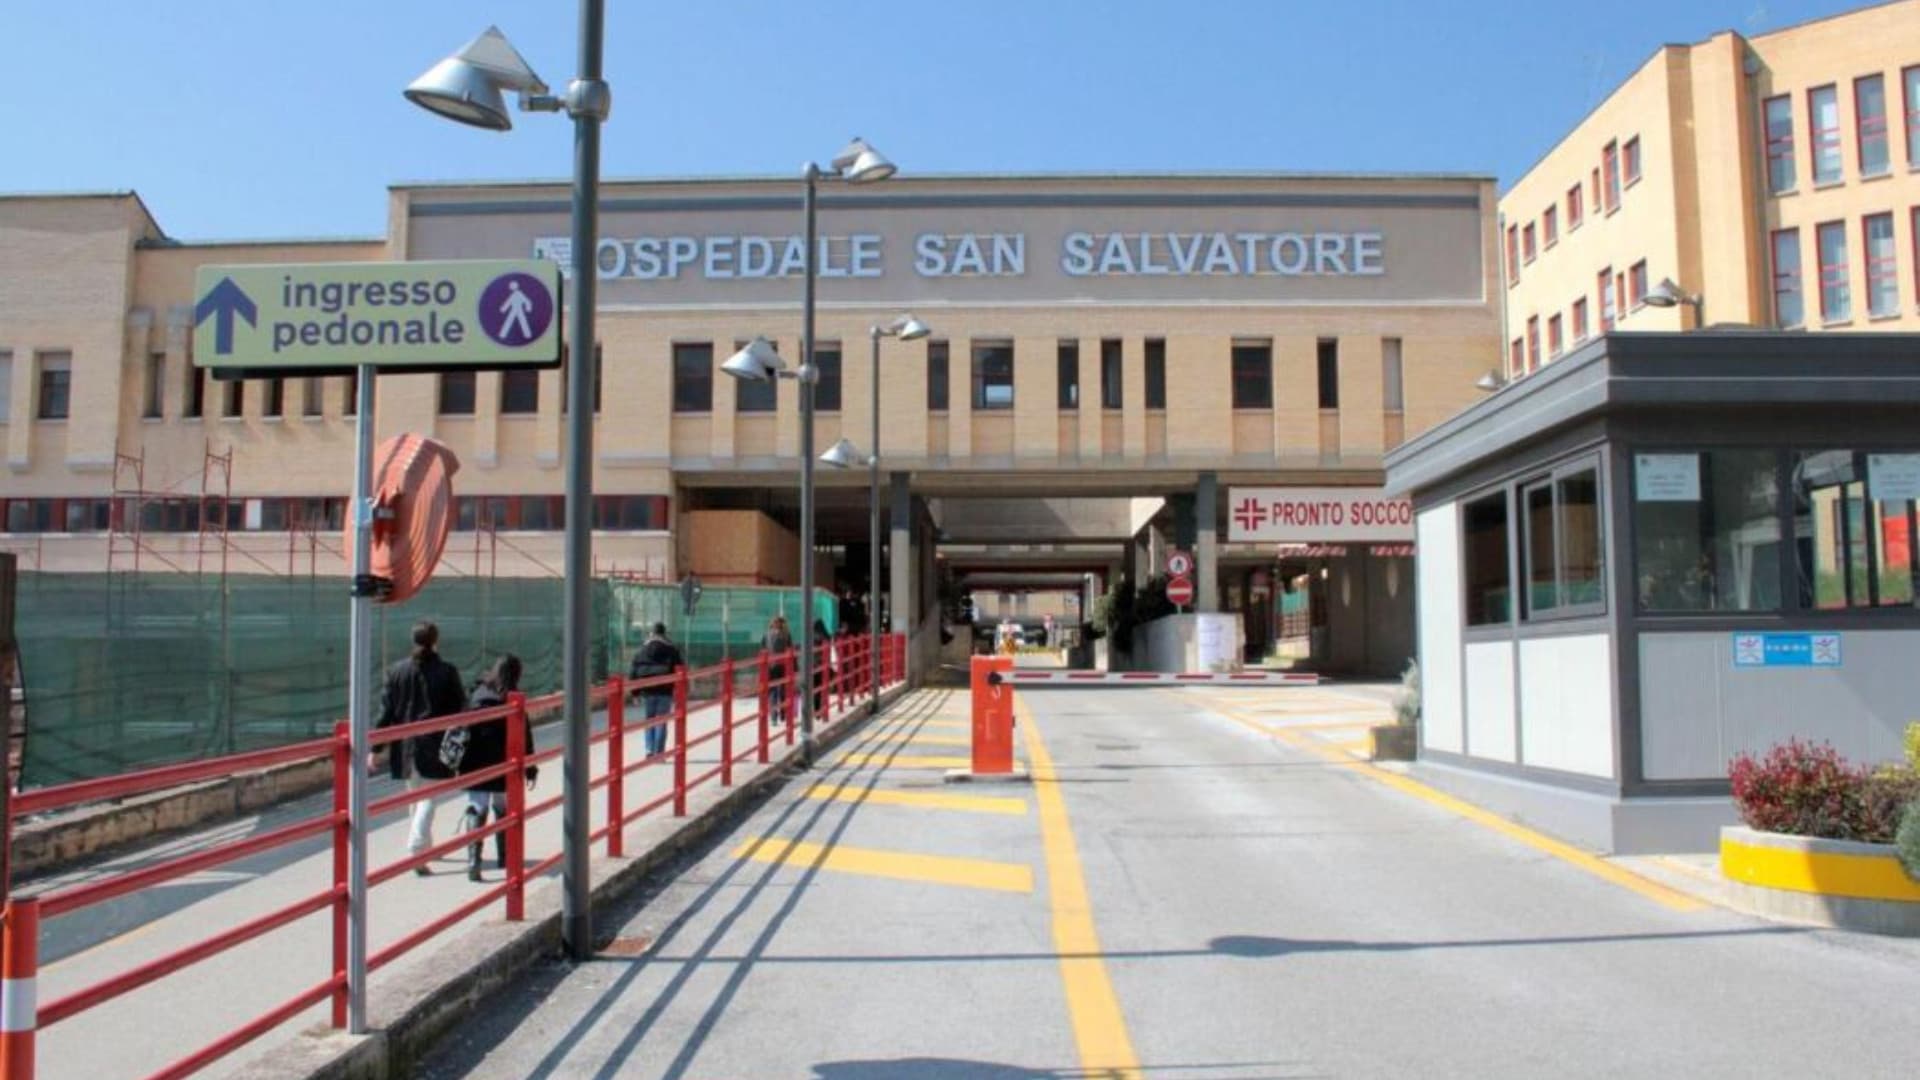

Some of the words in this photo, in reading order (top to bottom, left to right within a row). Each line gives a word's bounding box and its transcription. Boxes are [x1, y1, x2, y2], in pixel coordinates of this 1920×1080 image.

[596, 236, 882, 279] OSPEDALE
[914, 233, 1025, 275] SAN
[1062, 232, 1385, 275] SALVATORE
[282, 275, 457, 313] ingresso
[273, 311, 464, 352] pedonale
[1272, 502, 1344, 526] PRONTO
